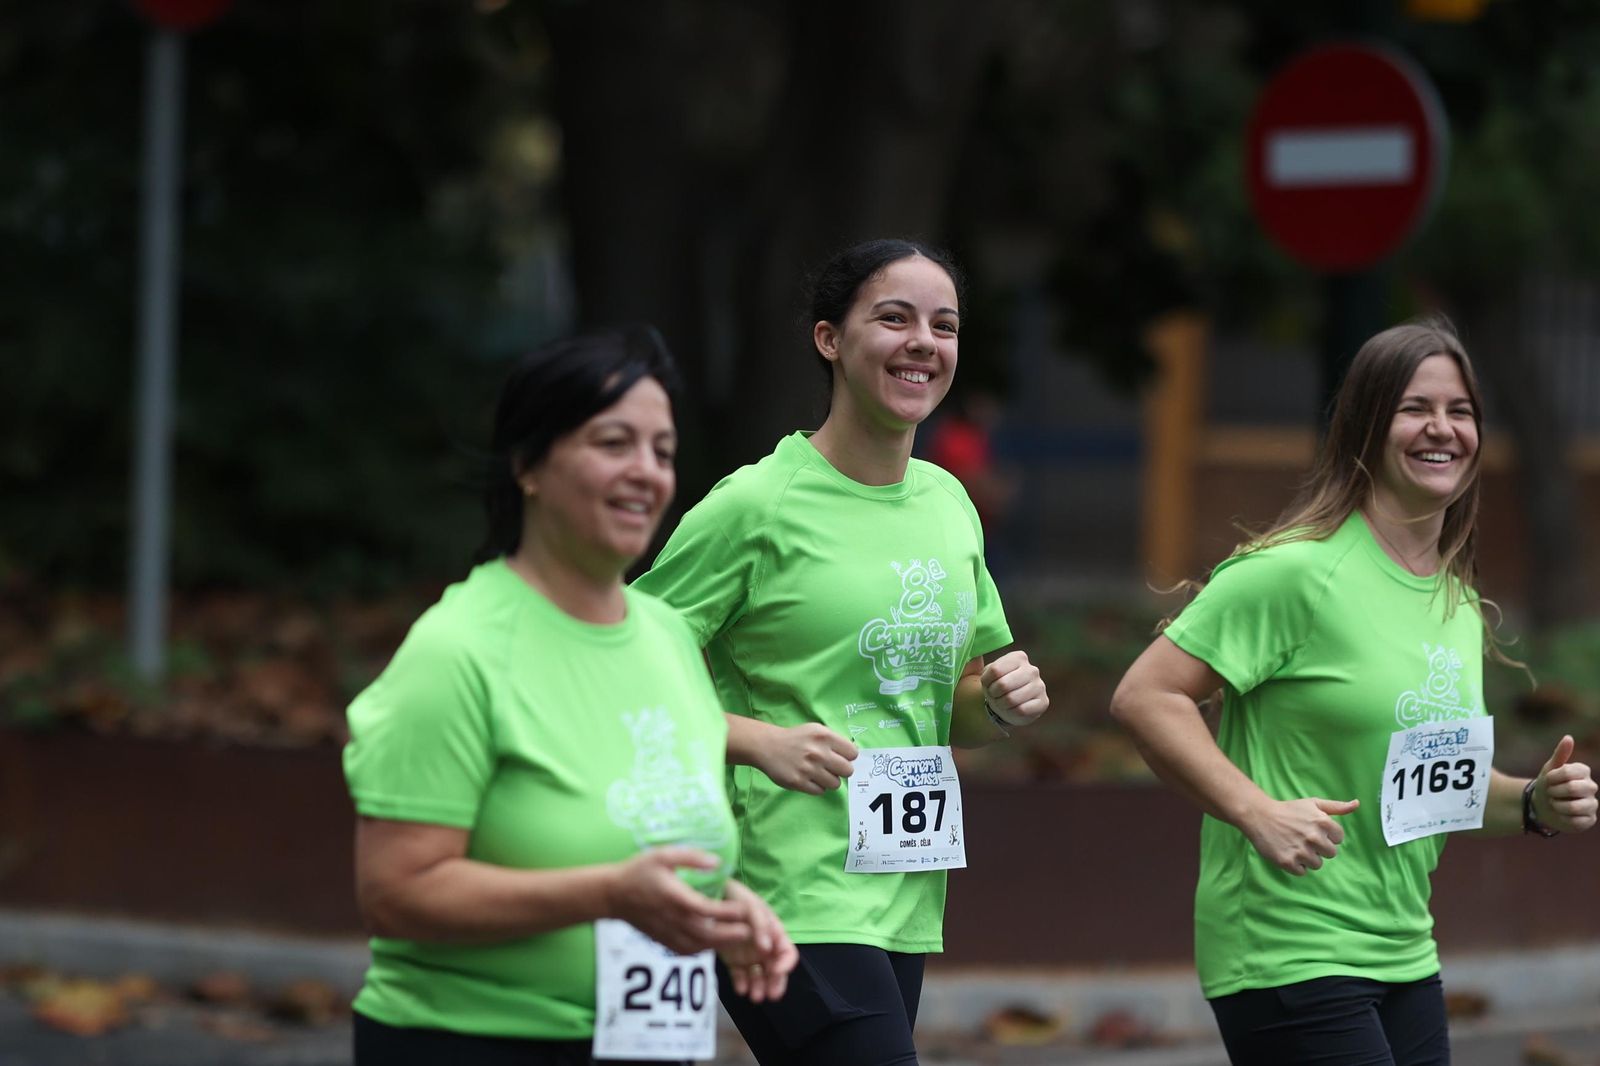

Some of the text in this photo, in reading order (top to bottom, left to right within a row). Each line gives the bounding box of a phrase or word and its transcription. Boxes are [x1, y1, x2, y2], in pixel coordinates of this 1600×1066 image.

[866, 624, 954, 652] Carrera
[890, 758, 936, 776] Carrera
[902, 772, 938, 786] Prensa
[1392, 758, 1476, 801] 1163
[868, 789, 946, 835] 187
[624, 965, 706, 1011] 240
